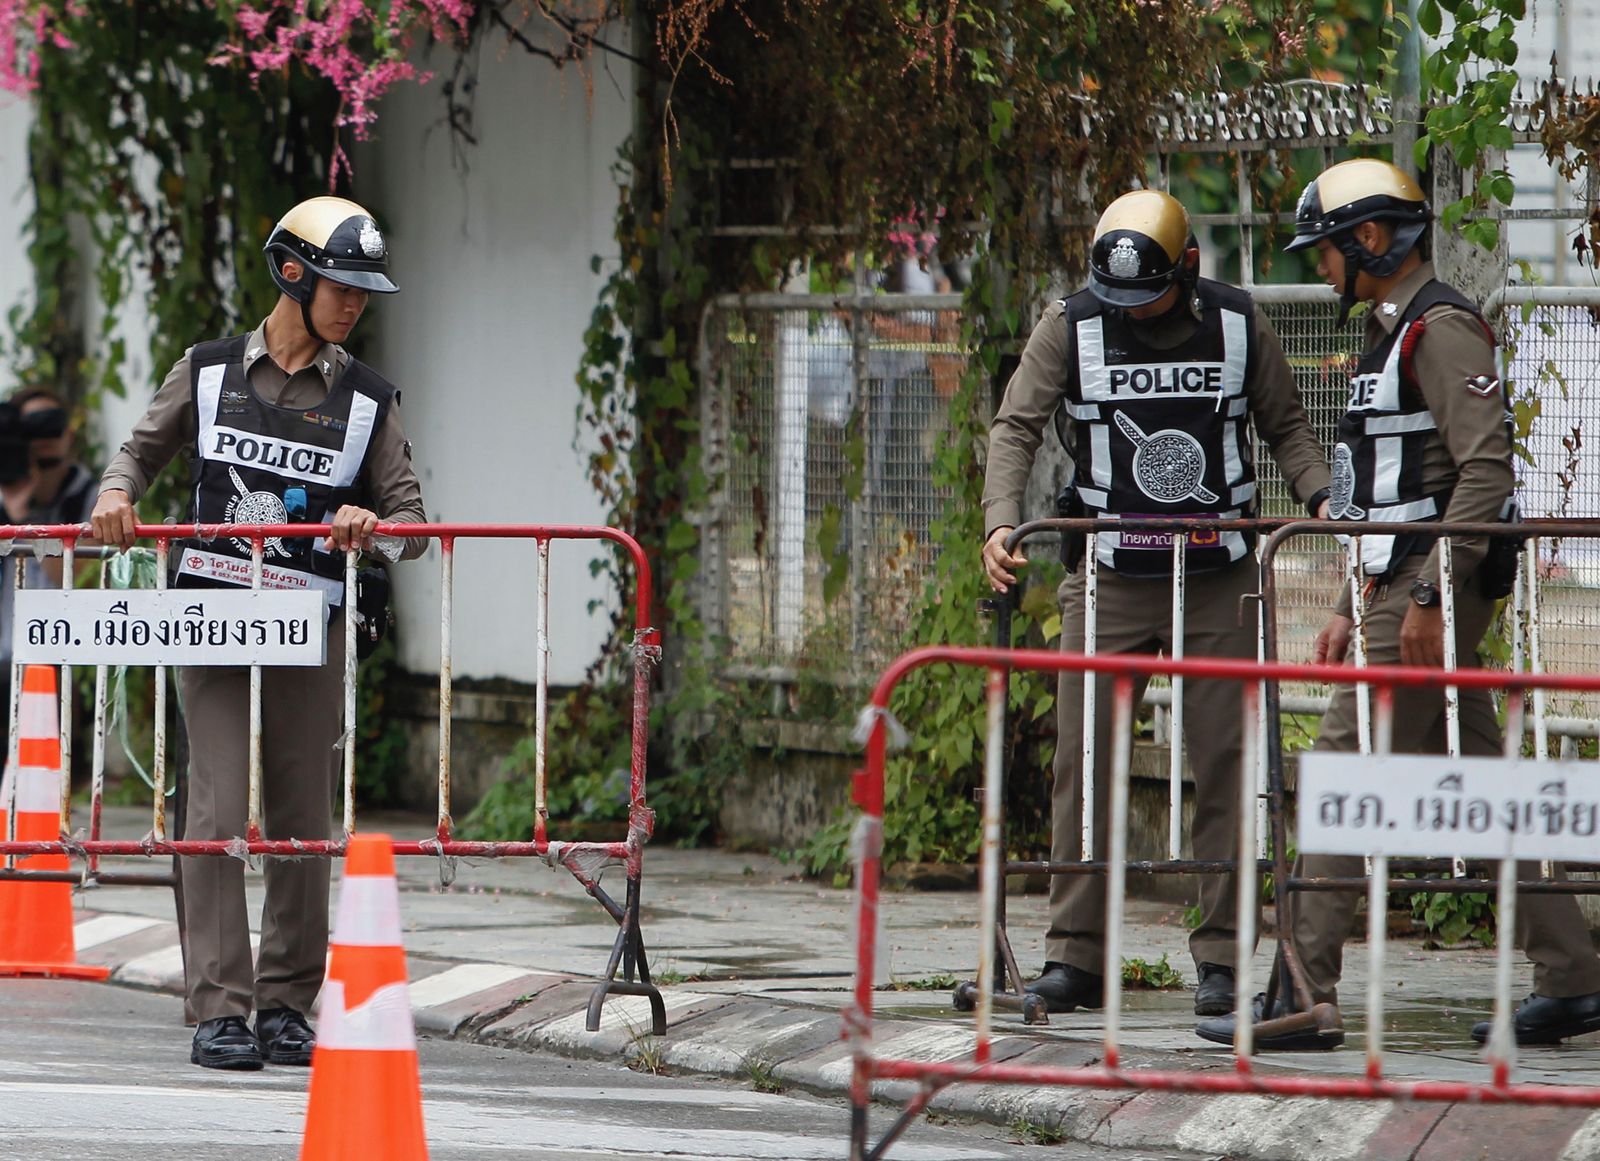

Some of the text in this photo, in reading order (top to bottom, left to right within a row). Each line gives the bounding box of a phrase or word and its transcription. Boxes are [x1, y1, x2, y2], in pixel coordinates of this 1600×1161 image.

[1110, 367, 1222, 394] POLICE
[213, 432, 334, 477] POLICE
[27, 600, 309, 646] สภ. เมืองเชียงราย
